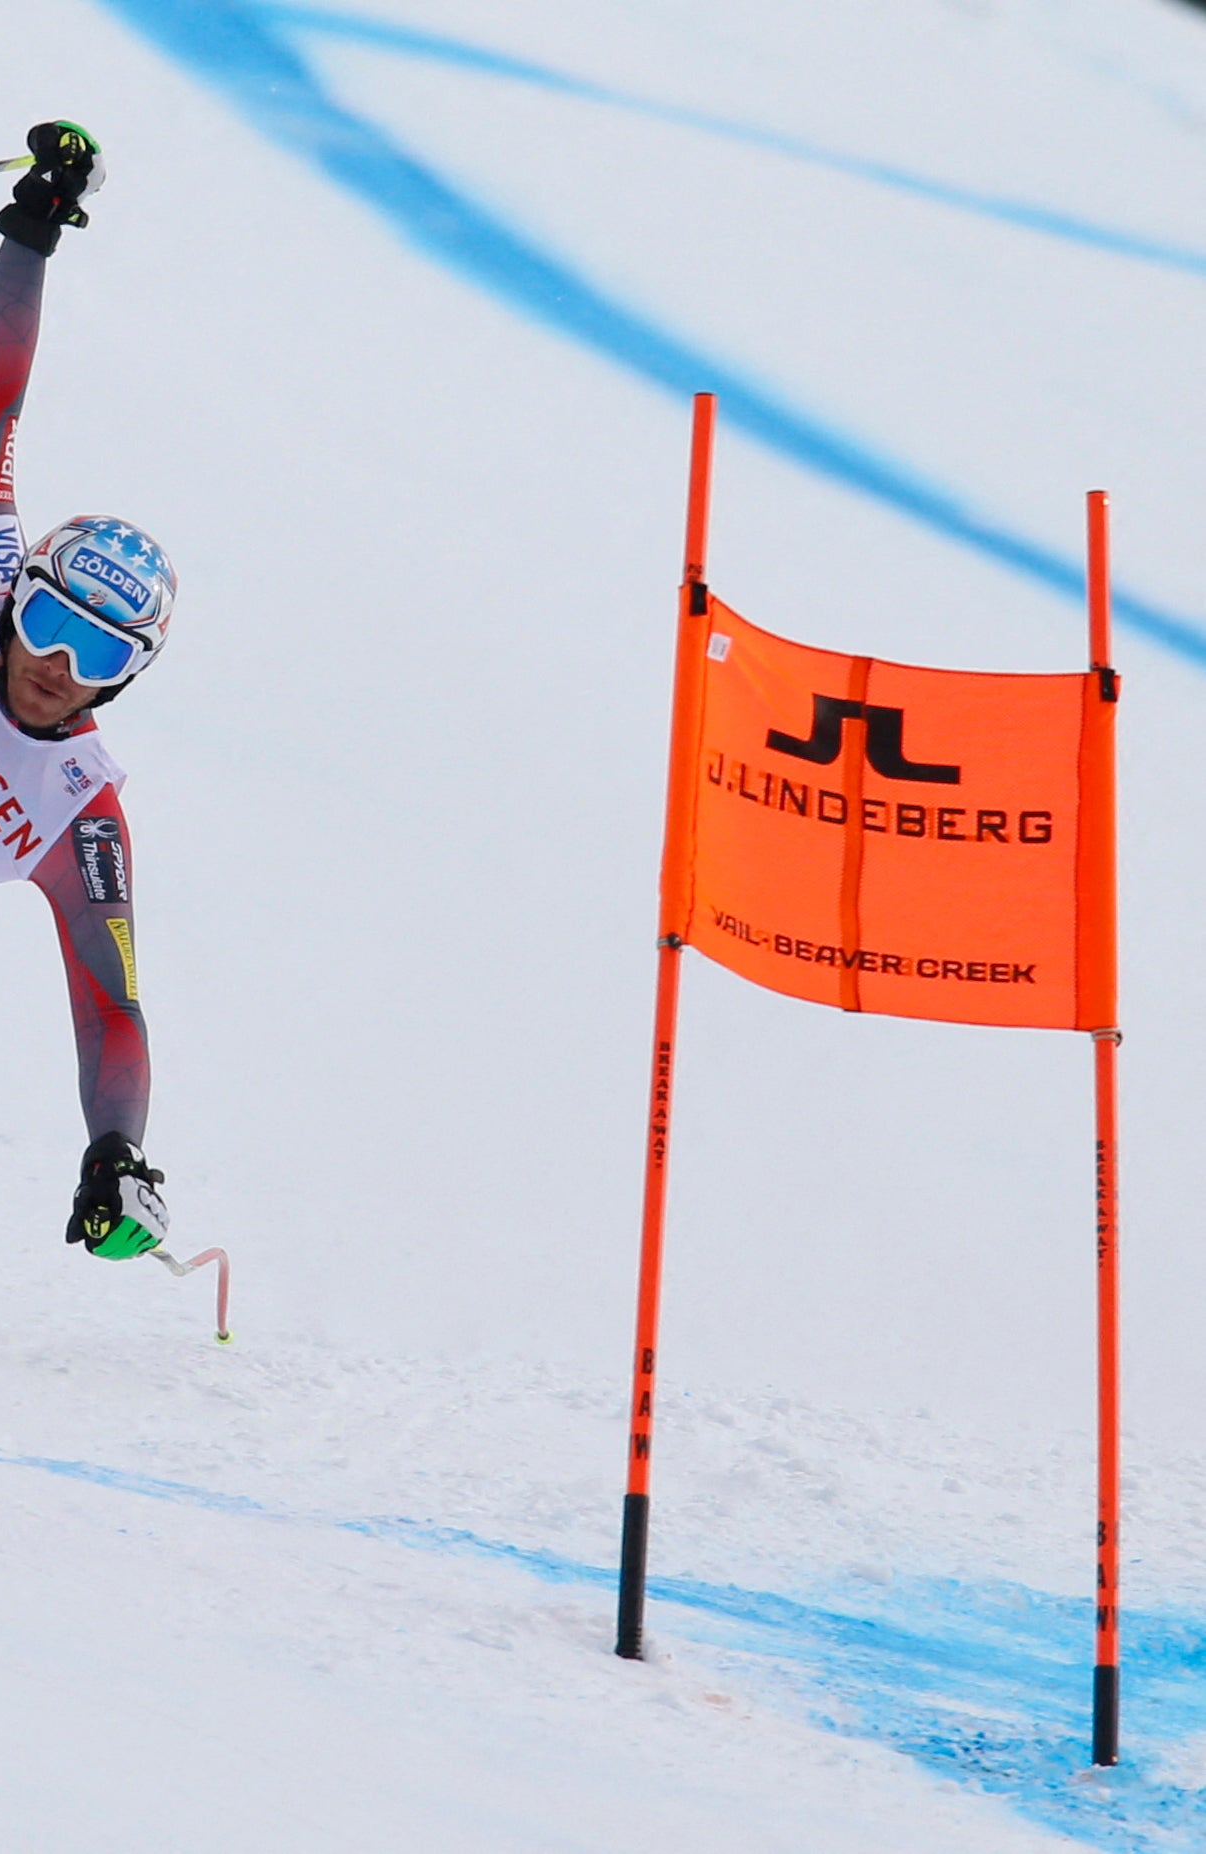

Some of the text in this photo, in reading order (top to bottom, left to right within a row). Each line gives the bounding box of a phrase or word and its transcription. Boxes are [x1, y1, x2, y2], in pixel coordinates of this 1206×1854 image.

[73, 554, 148, 605] SÖLDEN
[82, 841, 106, 900] Thinsulate
[110, 841, 128, 902] SPYDER
[916, 958, 1037, 984] CREEK
